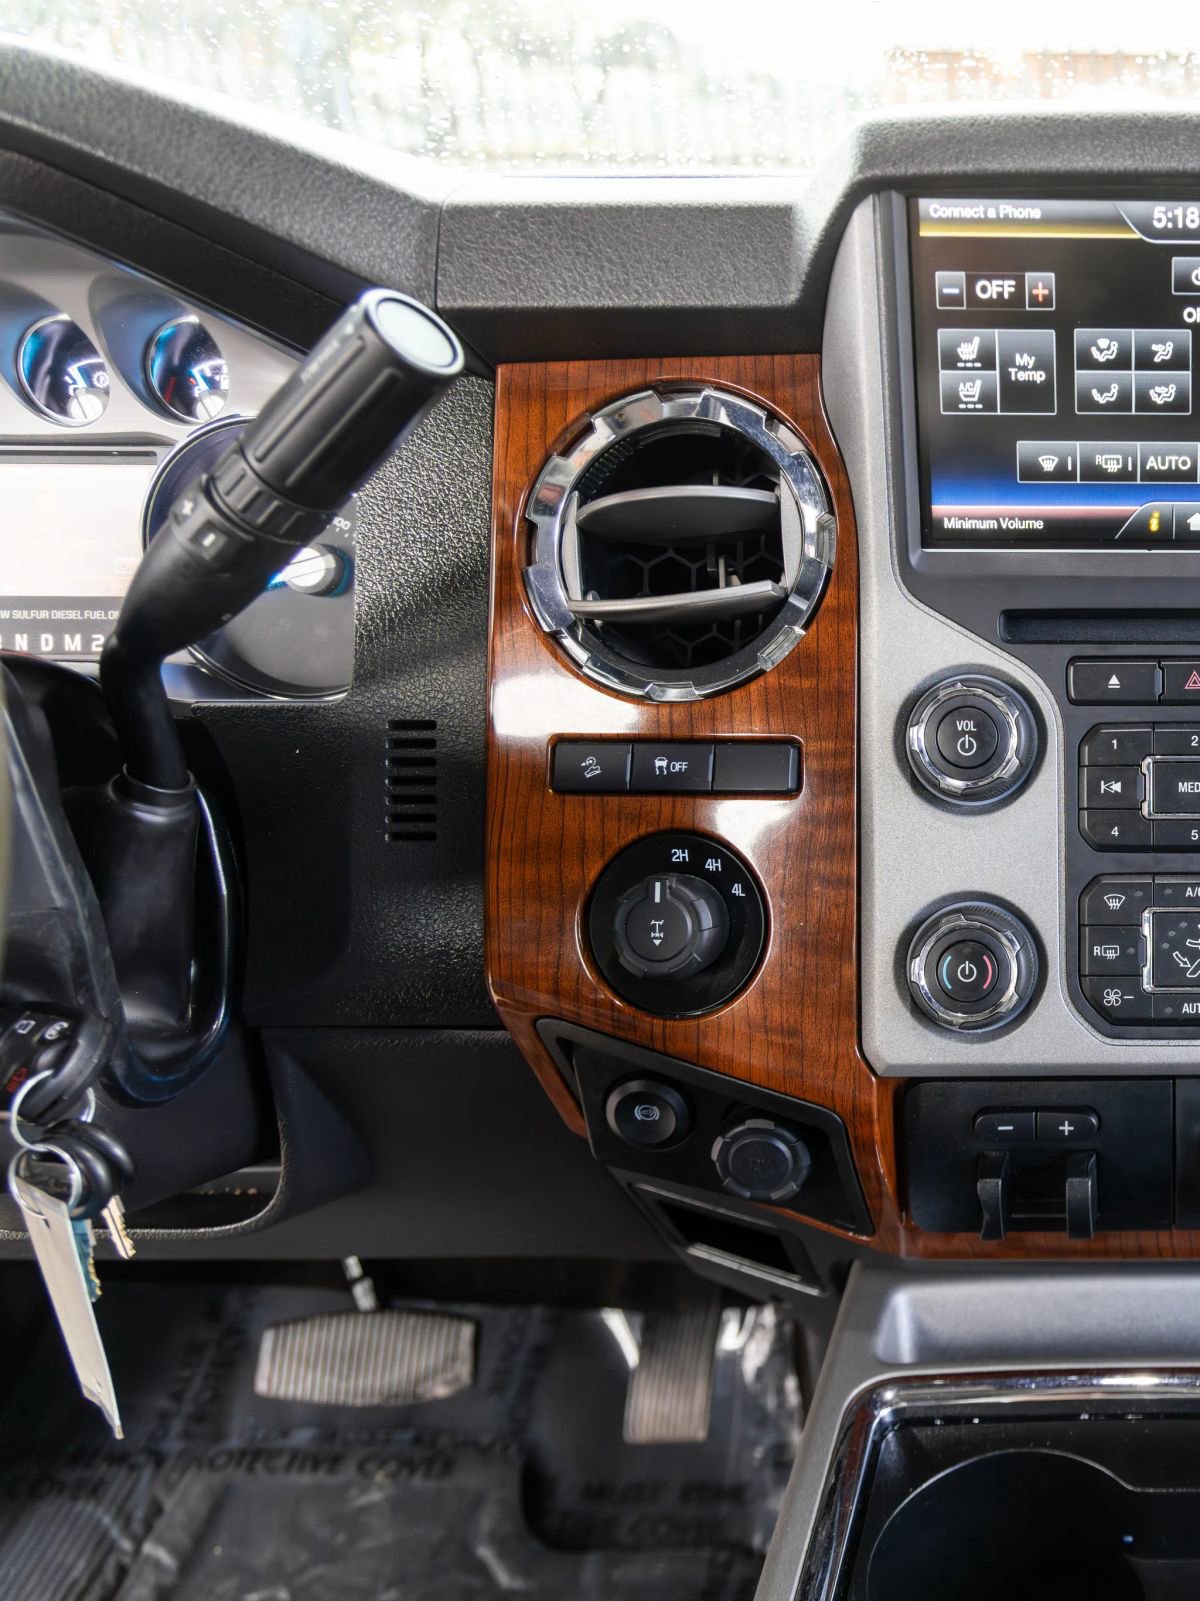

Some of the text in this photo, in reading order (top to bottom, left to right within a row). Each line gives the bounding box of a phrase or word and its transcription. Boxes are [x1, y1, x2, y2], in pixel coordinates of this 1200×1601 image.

[929, 204, 1041, 219] Connect a Phone
[1153, 206, 1200, 229] 5:18
[976, 281, 1016, 299] OFF
[1015, 353, 1035, 368] My
[1009, 368, 1046, 384] Temp
[1146, 456, 1191, 470] AUTO
[944, 517, 1044, 530] Minimum Volume
[12, 610, 49, 620] SULFUR
[51, 610, 84, 620] DIESEL
[85, 610, 107, 620] FUEL
[15, 633, 105, 652] N D M 2
[956, 720, 977, 732] VOL
[1111, 739, 1117, 750] 1
[1191, 735, 1199, 747] 2
[670, 761, 688, 773] OFF
[1111, 826, 1119, 837] 4
[1191, 830, 1199, 841] 5
[671, 848, 689, 862] 2H
[705, 858, 721, 872] 4H
[731, 884, 746, 897] 4L
[1094, 946, 1100, 957] R
